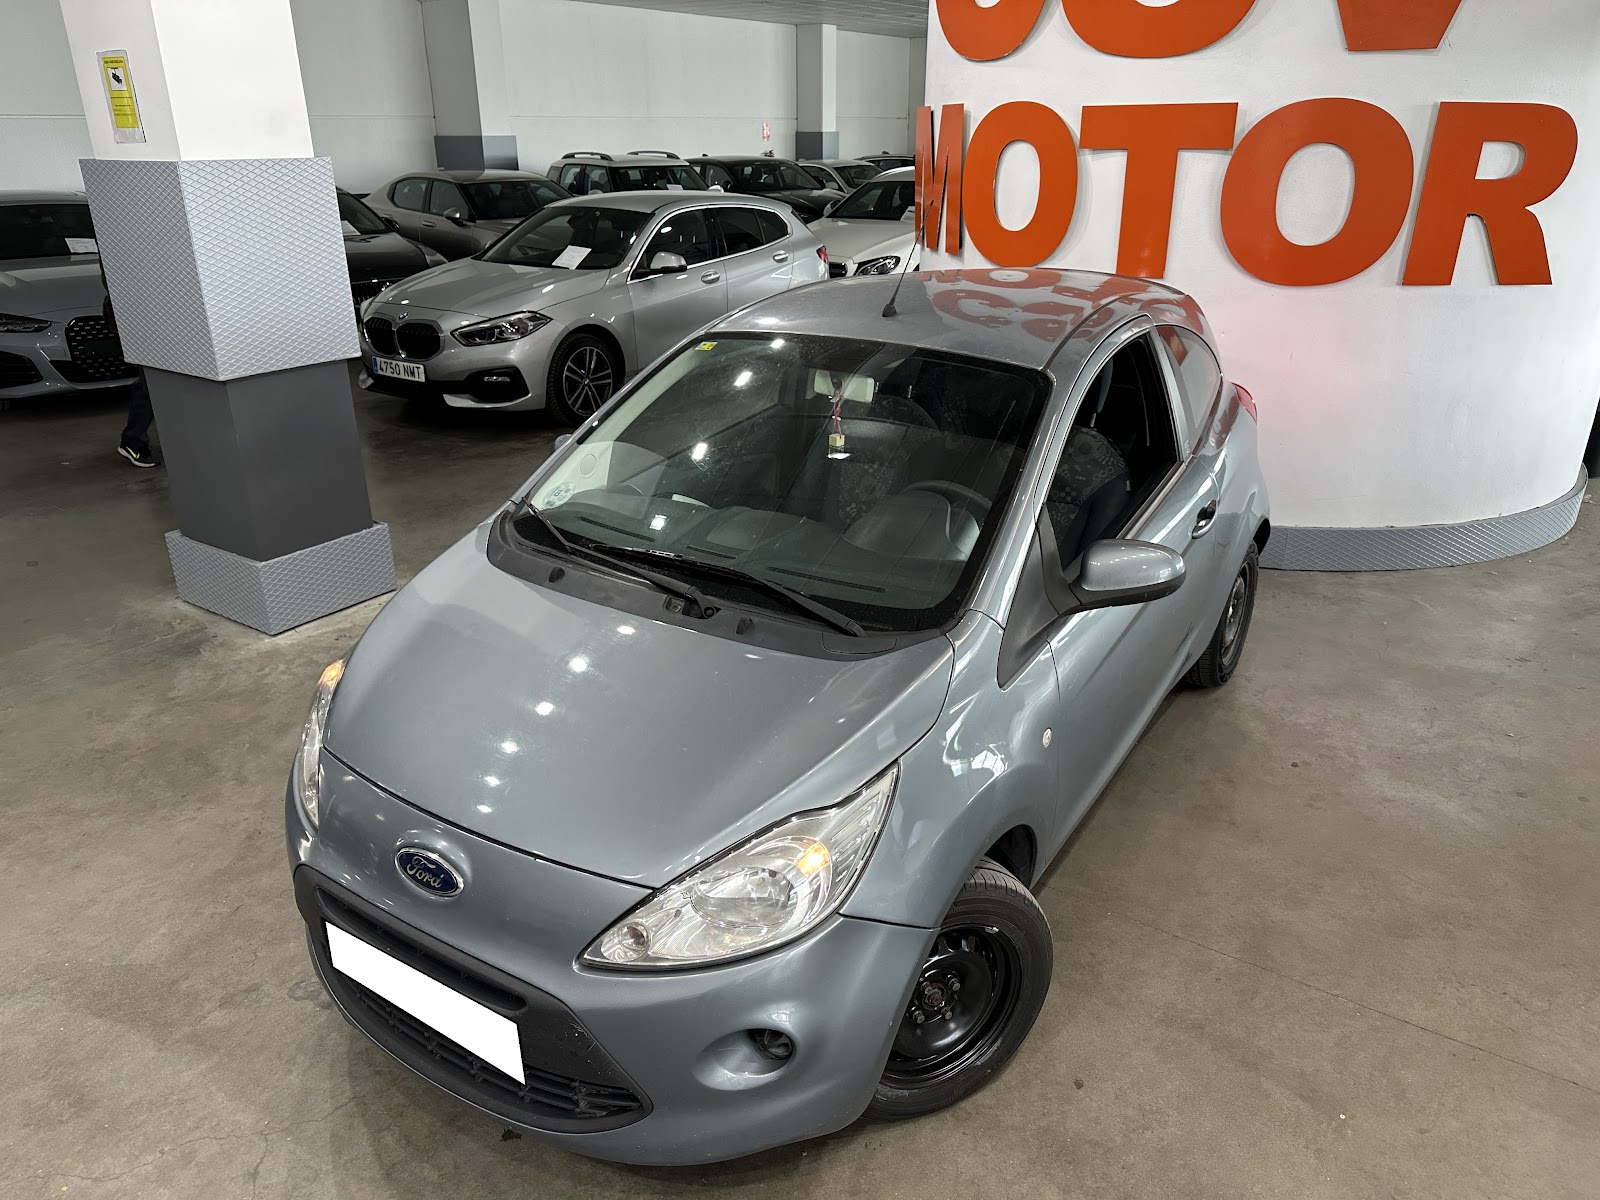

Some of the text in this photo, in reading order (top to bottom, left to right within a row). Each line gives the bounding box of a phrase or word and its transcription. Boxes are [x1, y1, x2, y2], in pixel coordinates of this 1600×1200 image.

[915, 97, 1579, 286] MOTOR
[379, 360, 421, 380] 4750 NMT
[406, 856, 445, 888] Ford
